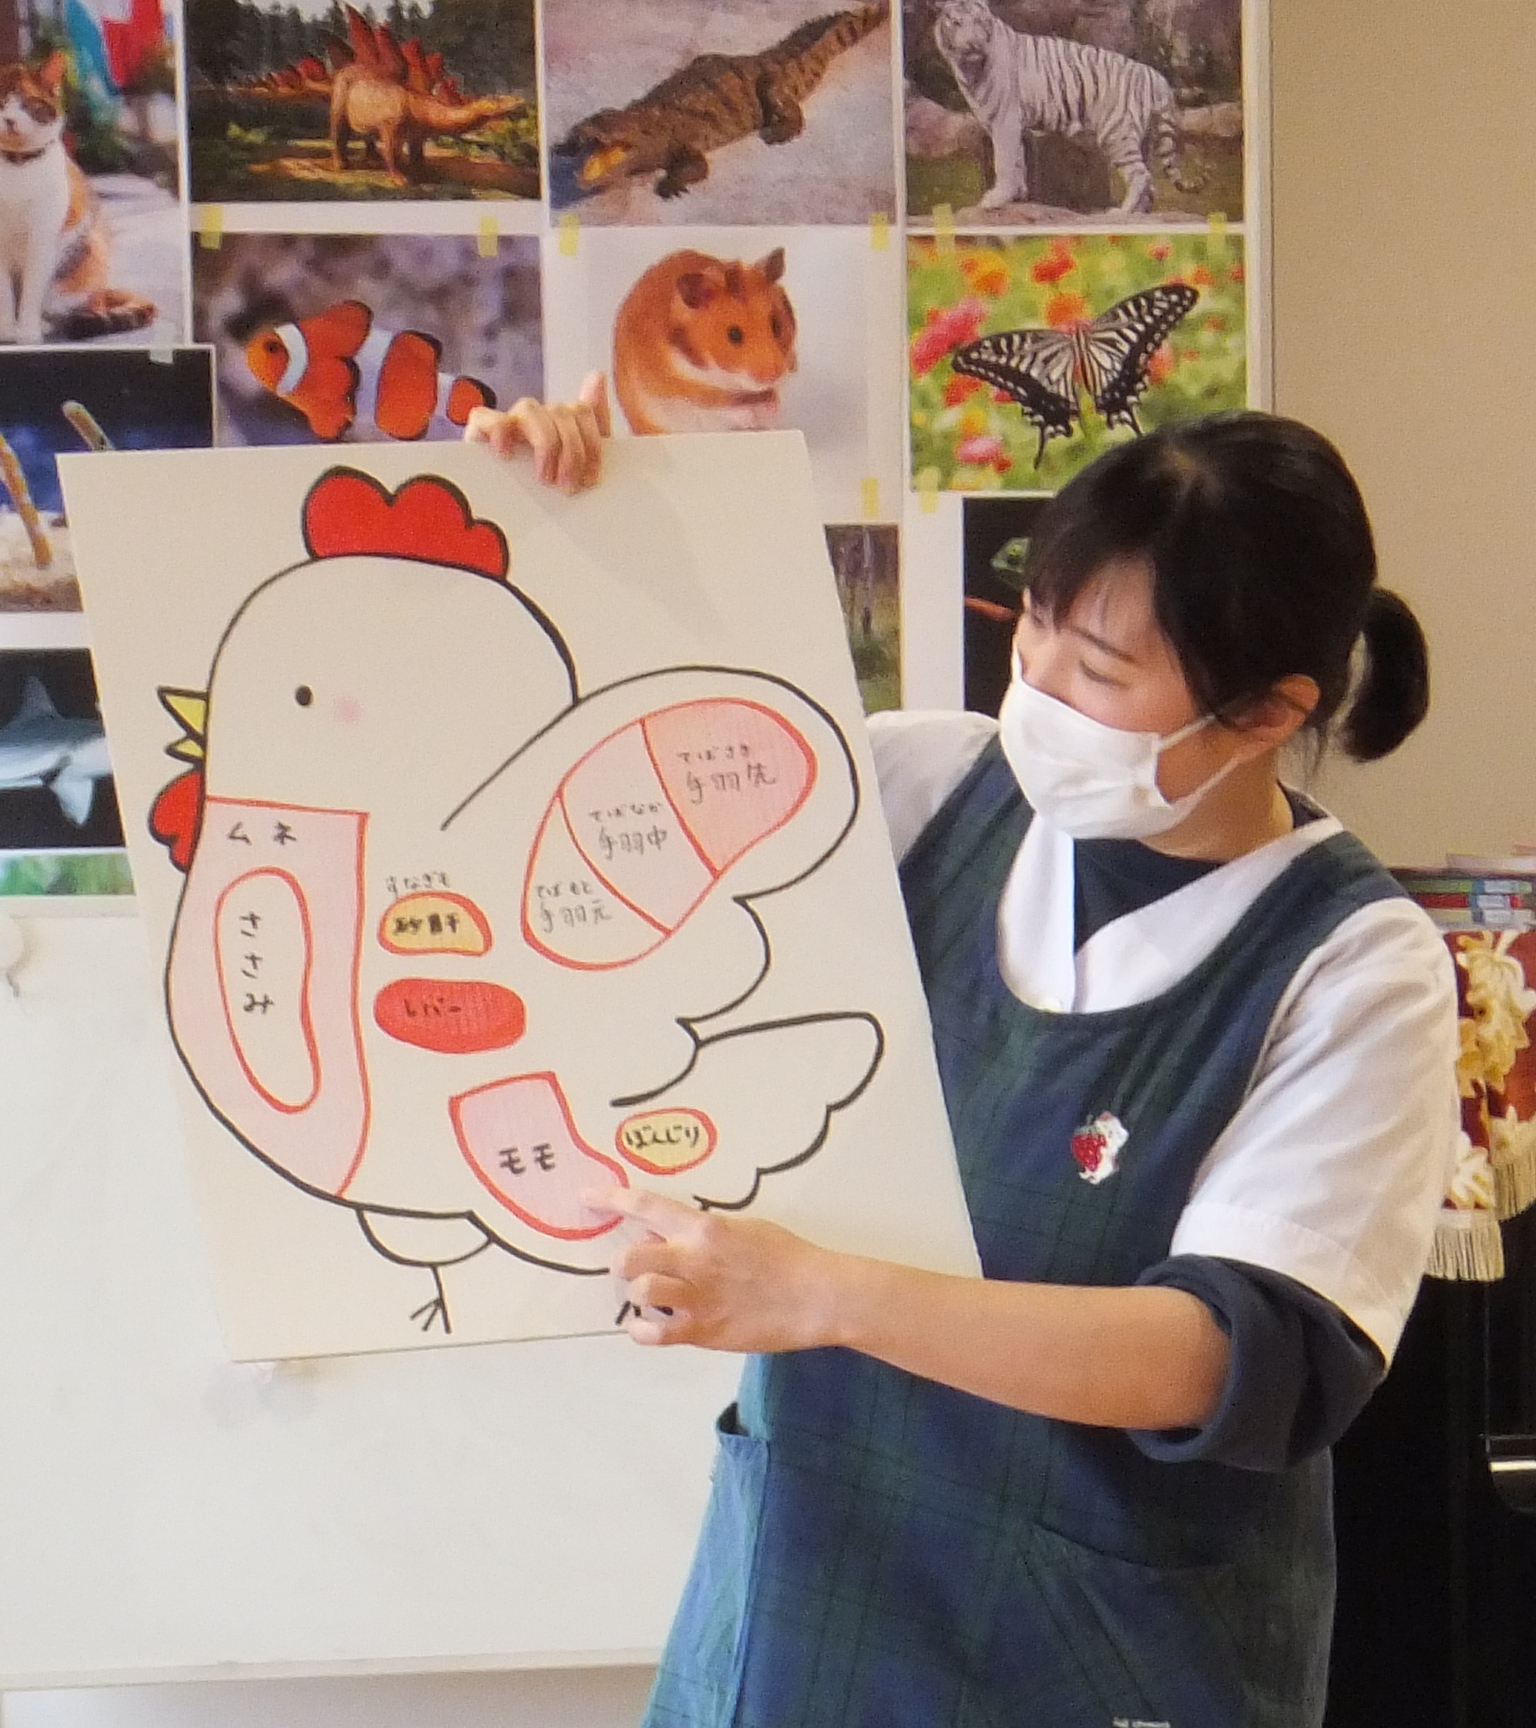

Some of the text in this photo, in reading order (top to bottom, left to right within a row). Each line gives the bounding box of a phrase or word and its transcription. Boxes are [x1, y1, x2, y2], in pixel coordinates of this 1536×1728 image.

[685, 761, 776, 805] 手羽先
[227, 820, 297, 846] ムネ
[598, 824, 668, 861] 手羽中
[539, 898, 613, 934] 手羽元
[238, 910, 276, 1016] ささみ
[403, 997, 462, 1018] レバー
[624, 1124, 701, 1150] ぼんじり
[498, 1142, 557, 1176] モモ
